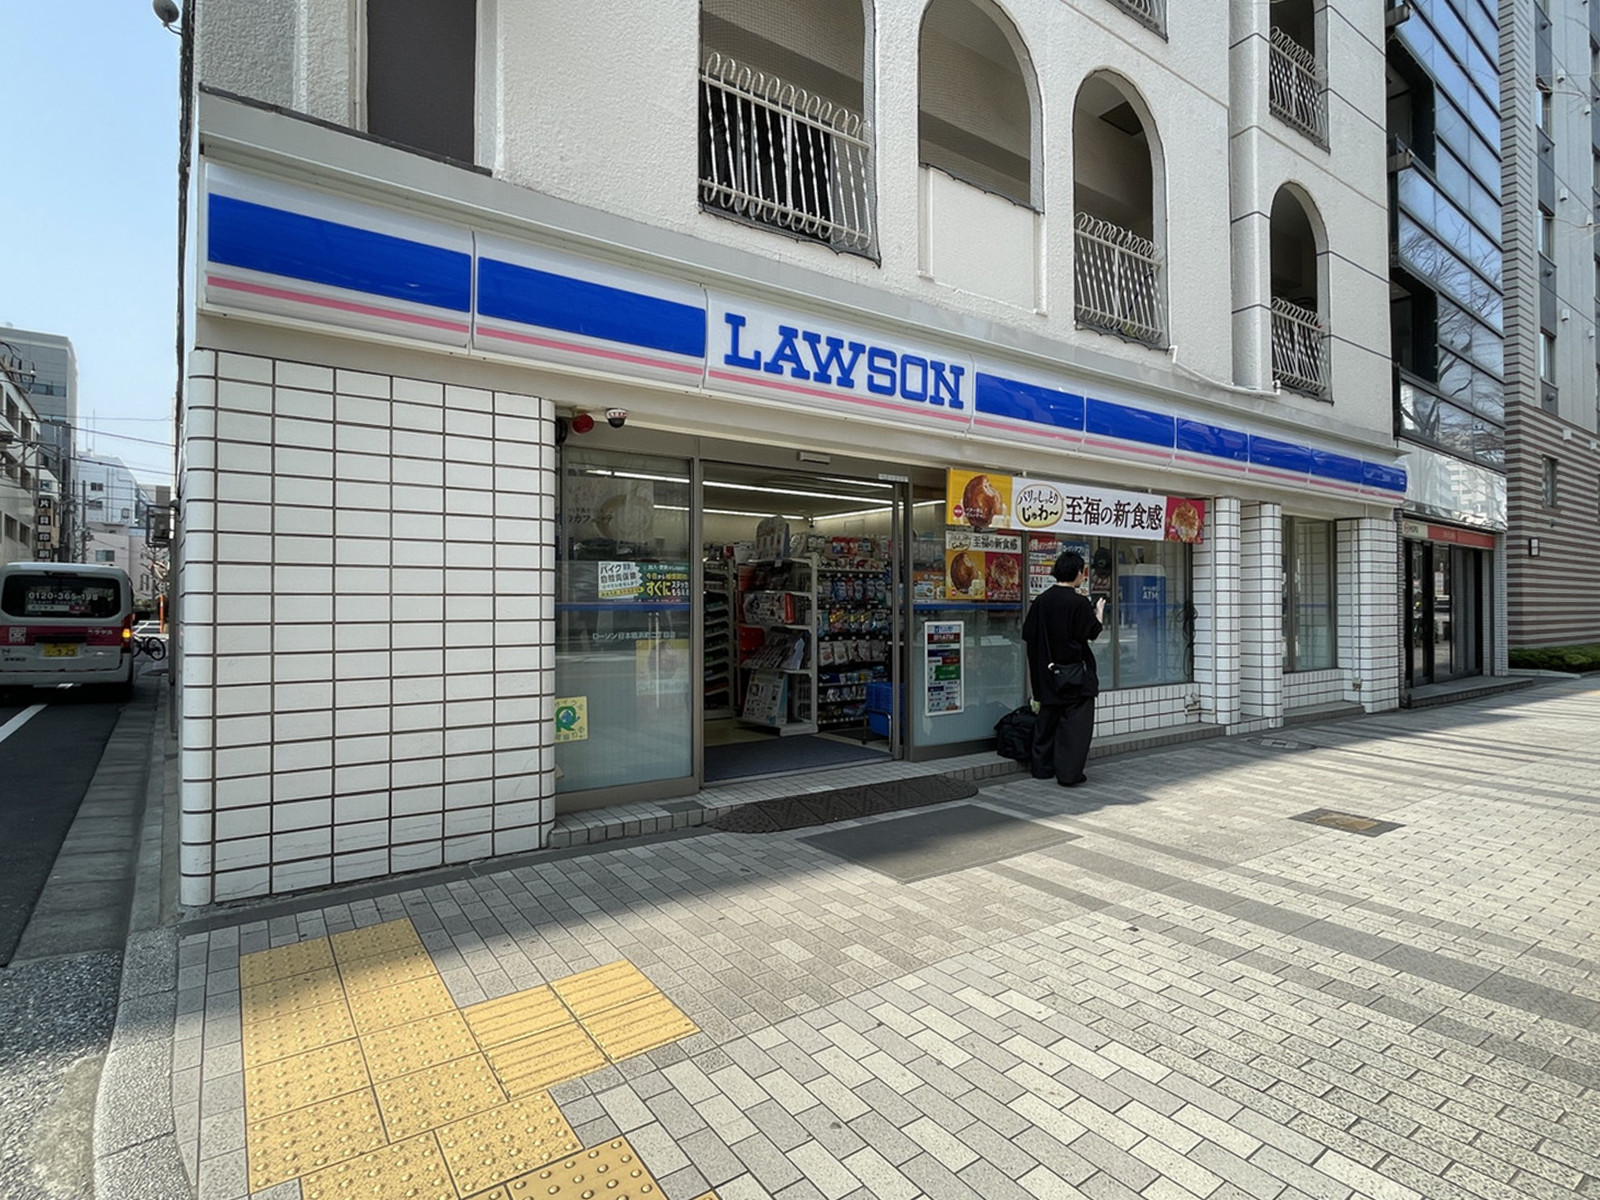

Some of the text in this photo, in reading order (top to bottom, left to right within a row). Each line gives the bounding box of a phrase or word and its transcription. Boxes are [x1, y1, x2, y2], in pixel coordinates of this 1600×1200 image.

[723, 312, 965, 410] LAWSON
[1063, 495, 1164, 530] 至福の新食感
[972, 535, 1018, 550] 至福の新食感
[600, 562, 622, 575] バイク
[646, 581, 672, 597] すぐに
